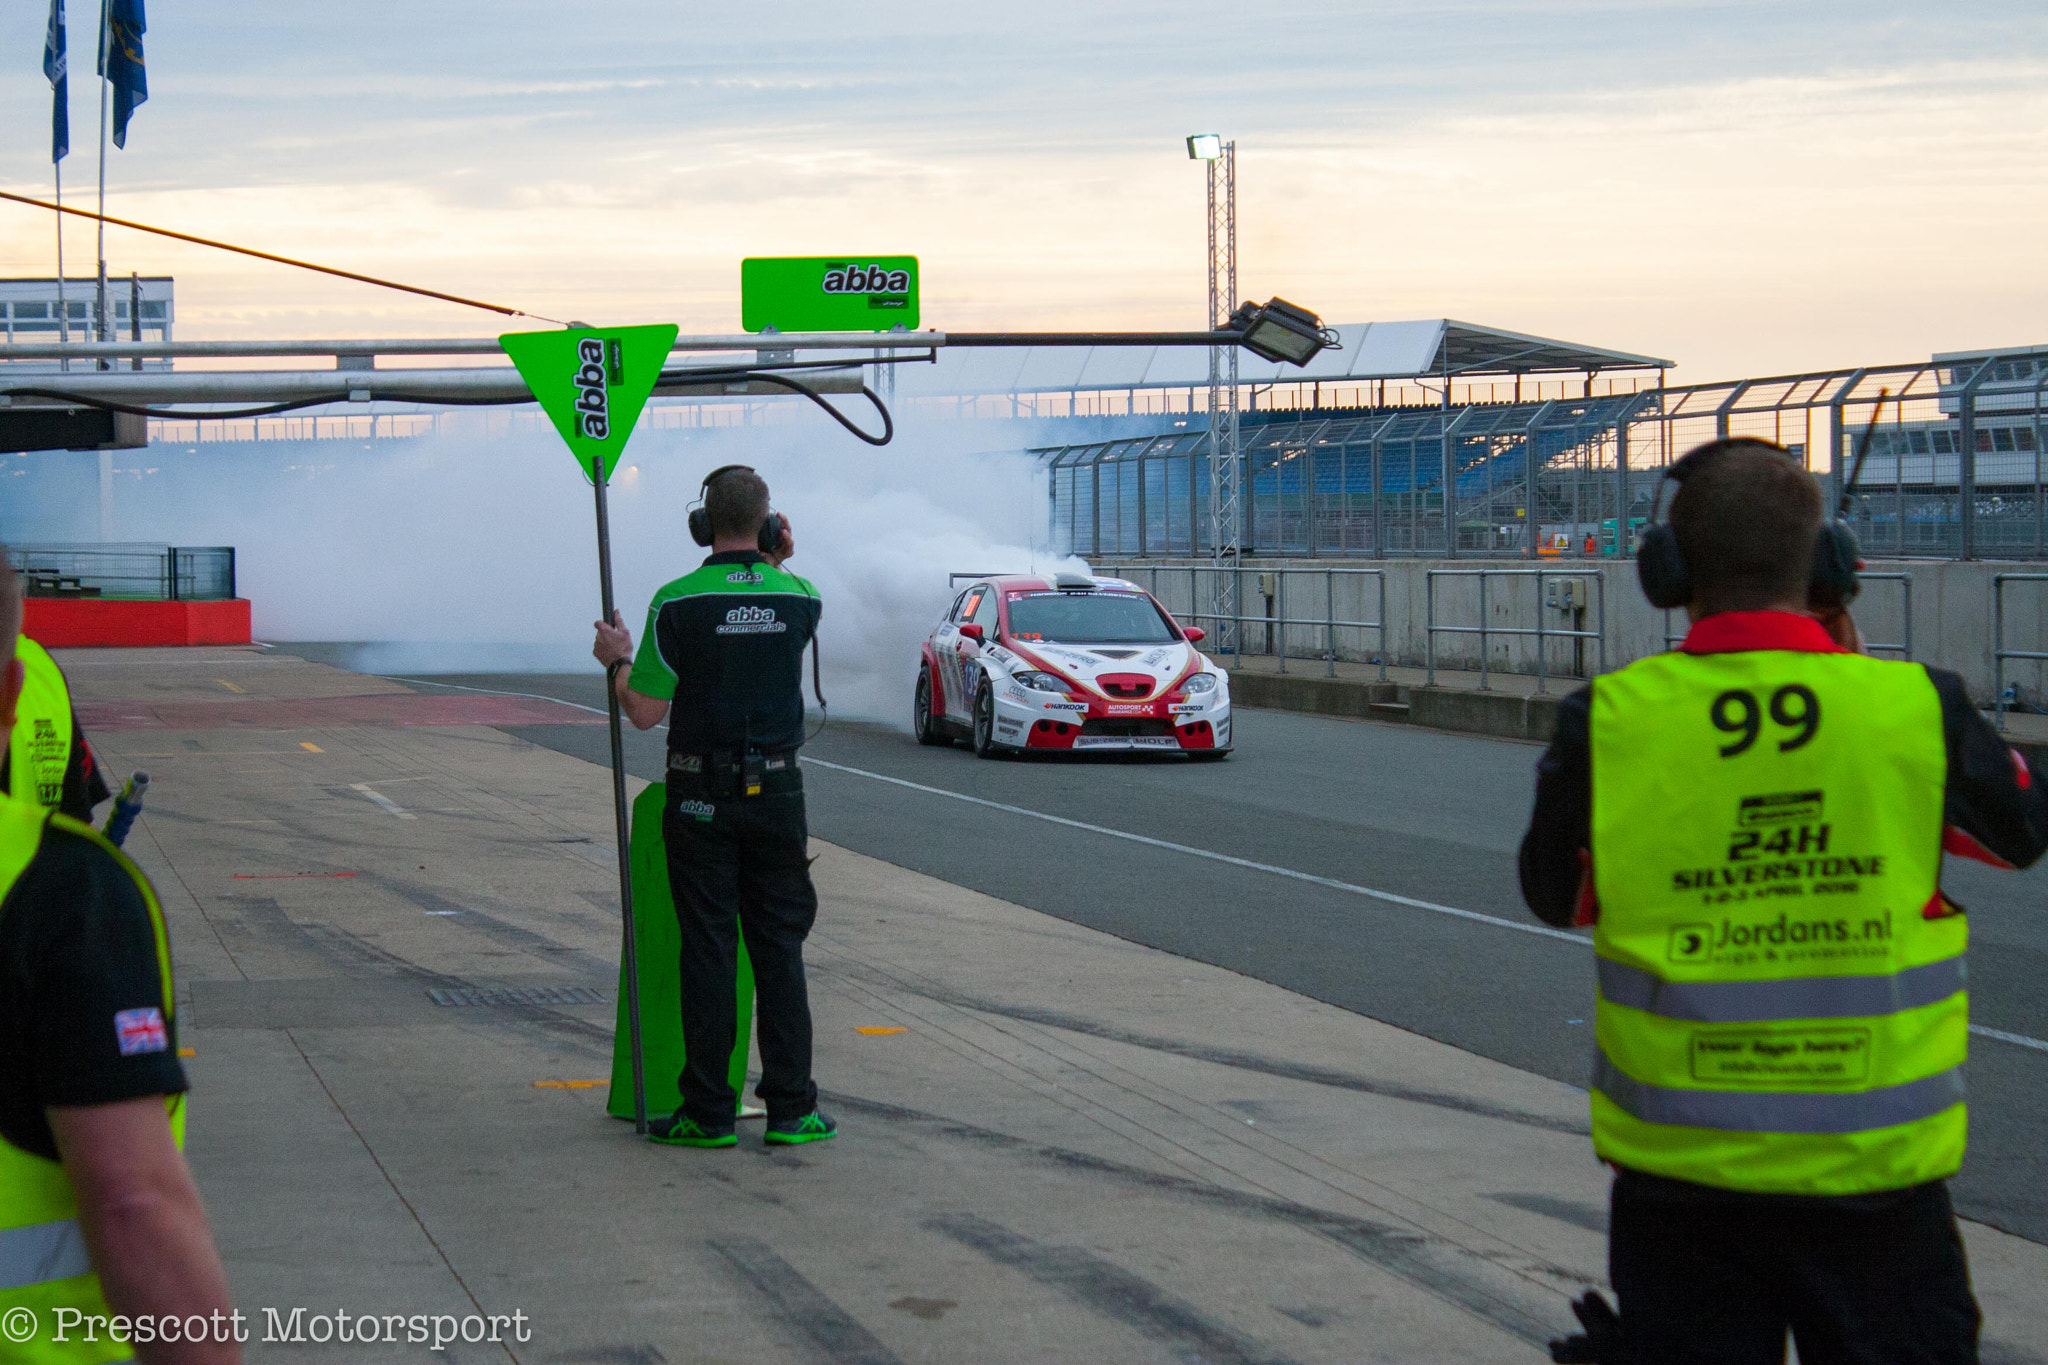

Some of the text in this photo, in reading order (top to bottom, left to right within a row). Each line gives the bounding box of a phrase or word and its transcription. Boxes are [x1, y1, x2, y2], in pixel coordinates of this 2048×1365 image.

[822, 264, 910, 294] abba
[573, 337, 610, 440] abba
[727, 571, 763, 582] abba
[716, 621, 786, 633] commercials
[726, 606, 775, 623] abba
[1710, 684, 1820, 758] 99
[680, 801, 715, 815] abba
[1728, 823, 1832, 861] 24H
[1672, 855, 1887, 891] SILVERSTONE
[1715, 909, 1892, 949] Jordans.nl
